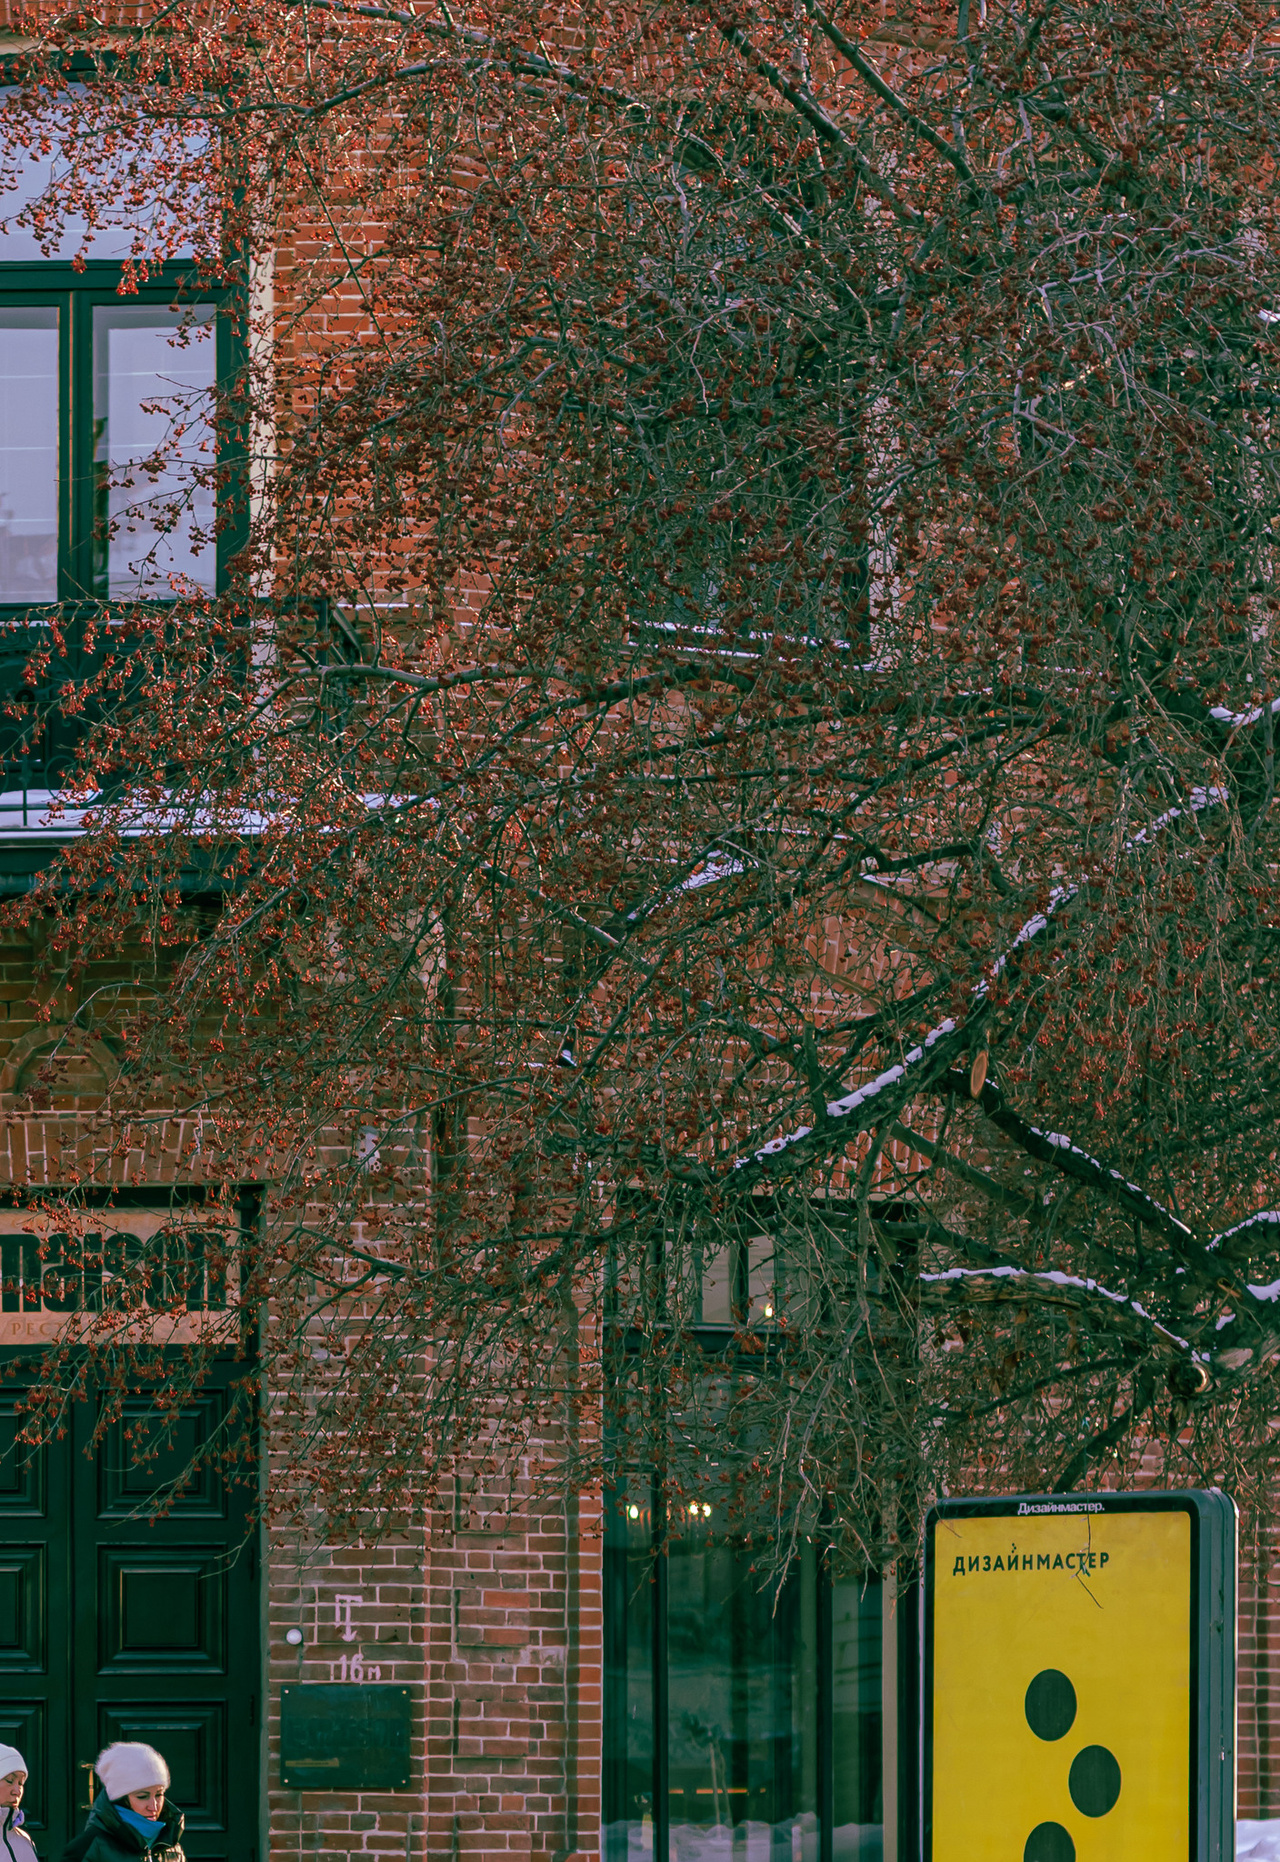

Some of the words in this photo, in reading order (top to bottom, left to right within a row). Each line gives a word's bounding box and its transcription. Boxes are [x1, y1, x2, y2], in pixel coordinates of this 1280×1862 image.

[1017, 1502, 1105, 1515] Дизайнмастер.
[953, 1543, 1109, 1576] ДИЗАЙНМАСТЕР
[339, 1653, 365, 1682] 16
